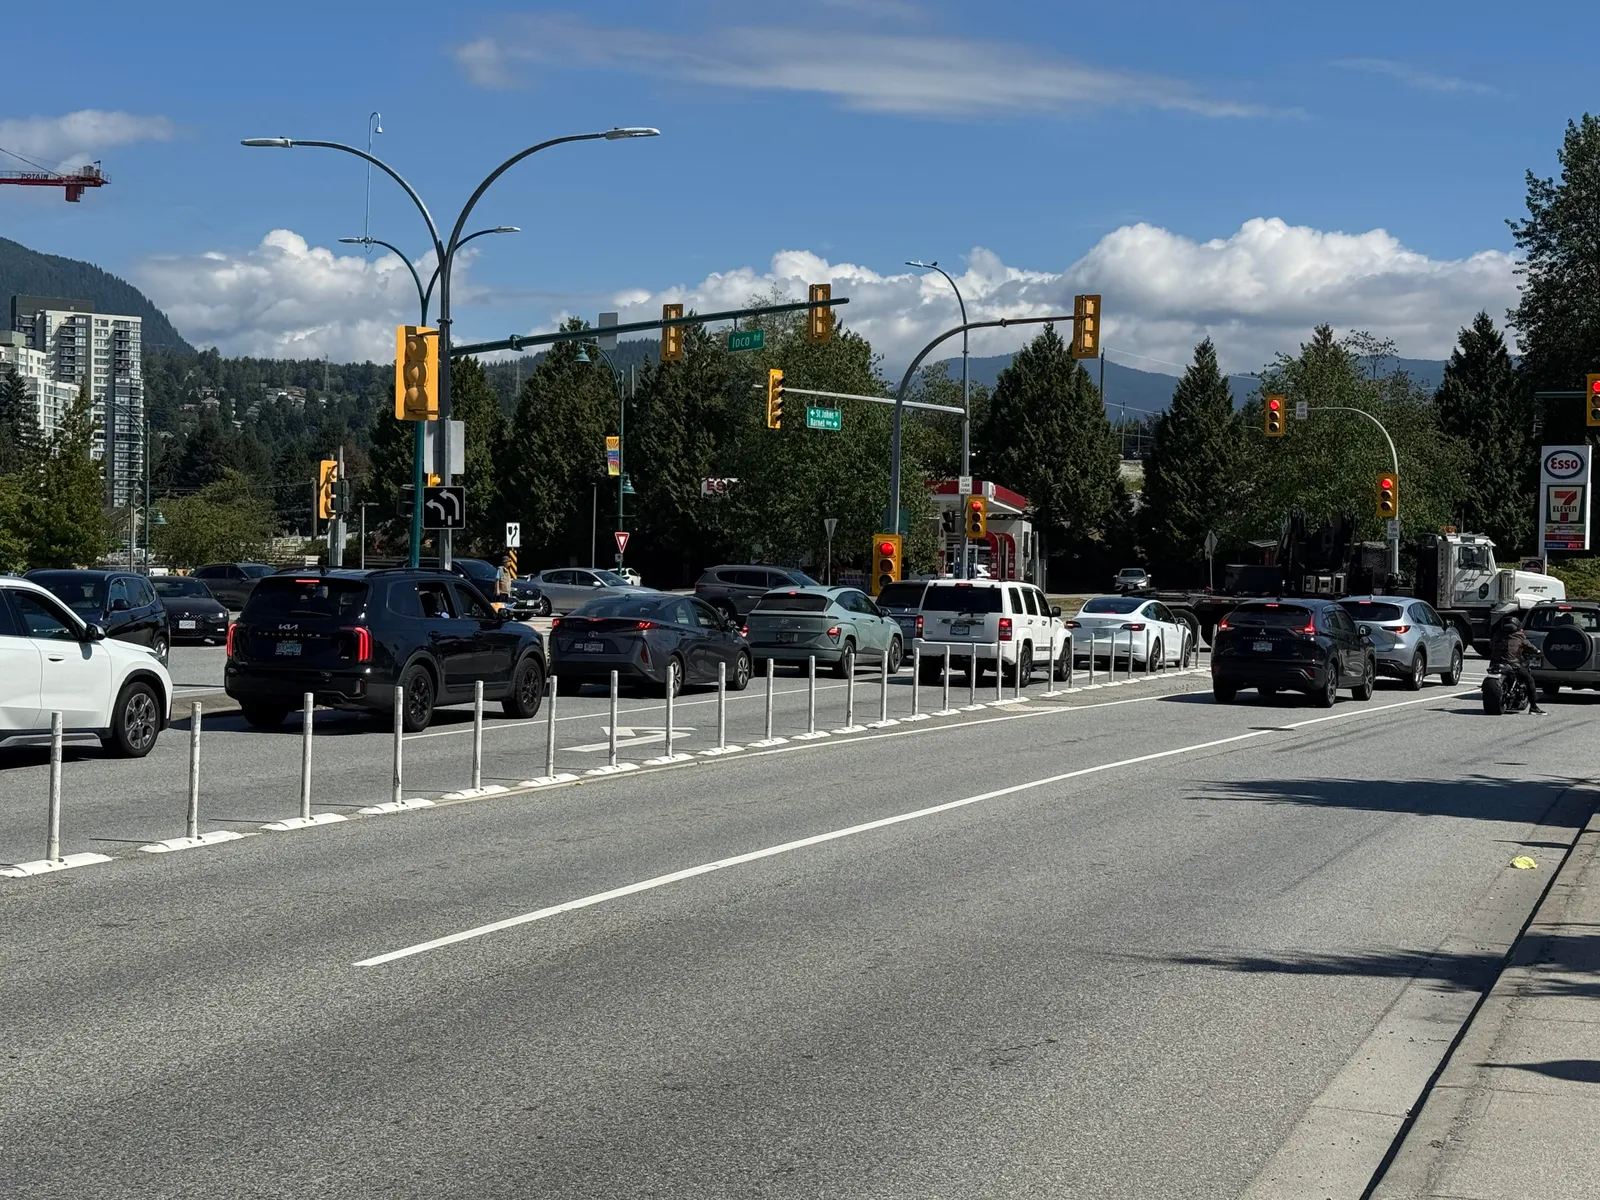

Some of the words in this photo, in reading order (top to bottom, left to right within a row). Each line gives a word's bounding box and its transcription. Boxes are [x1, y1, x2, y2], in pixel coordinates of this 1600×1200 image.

[816, 410, 821, 418] St
[810, 418, 825, 427] Barnet
[1554, 490, 1577, 522] 7
